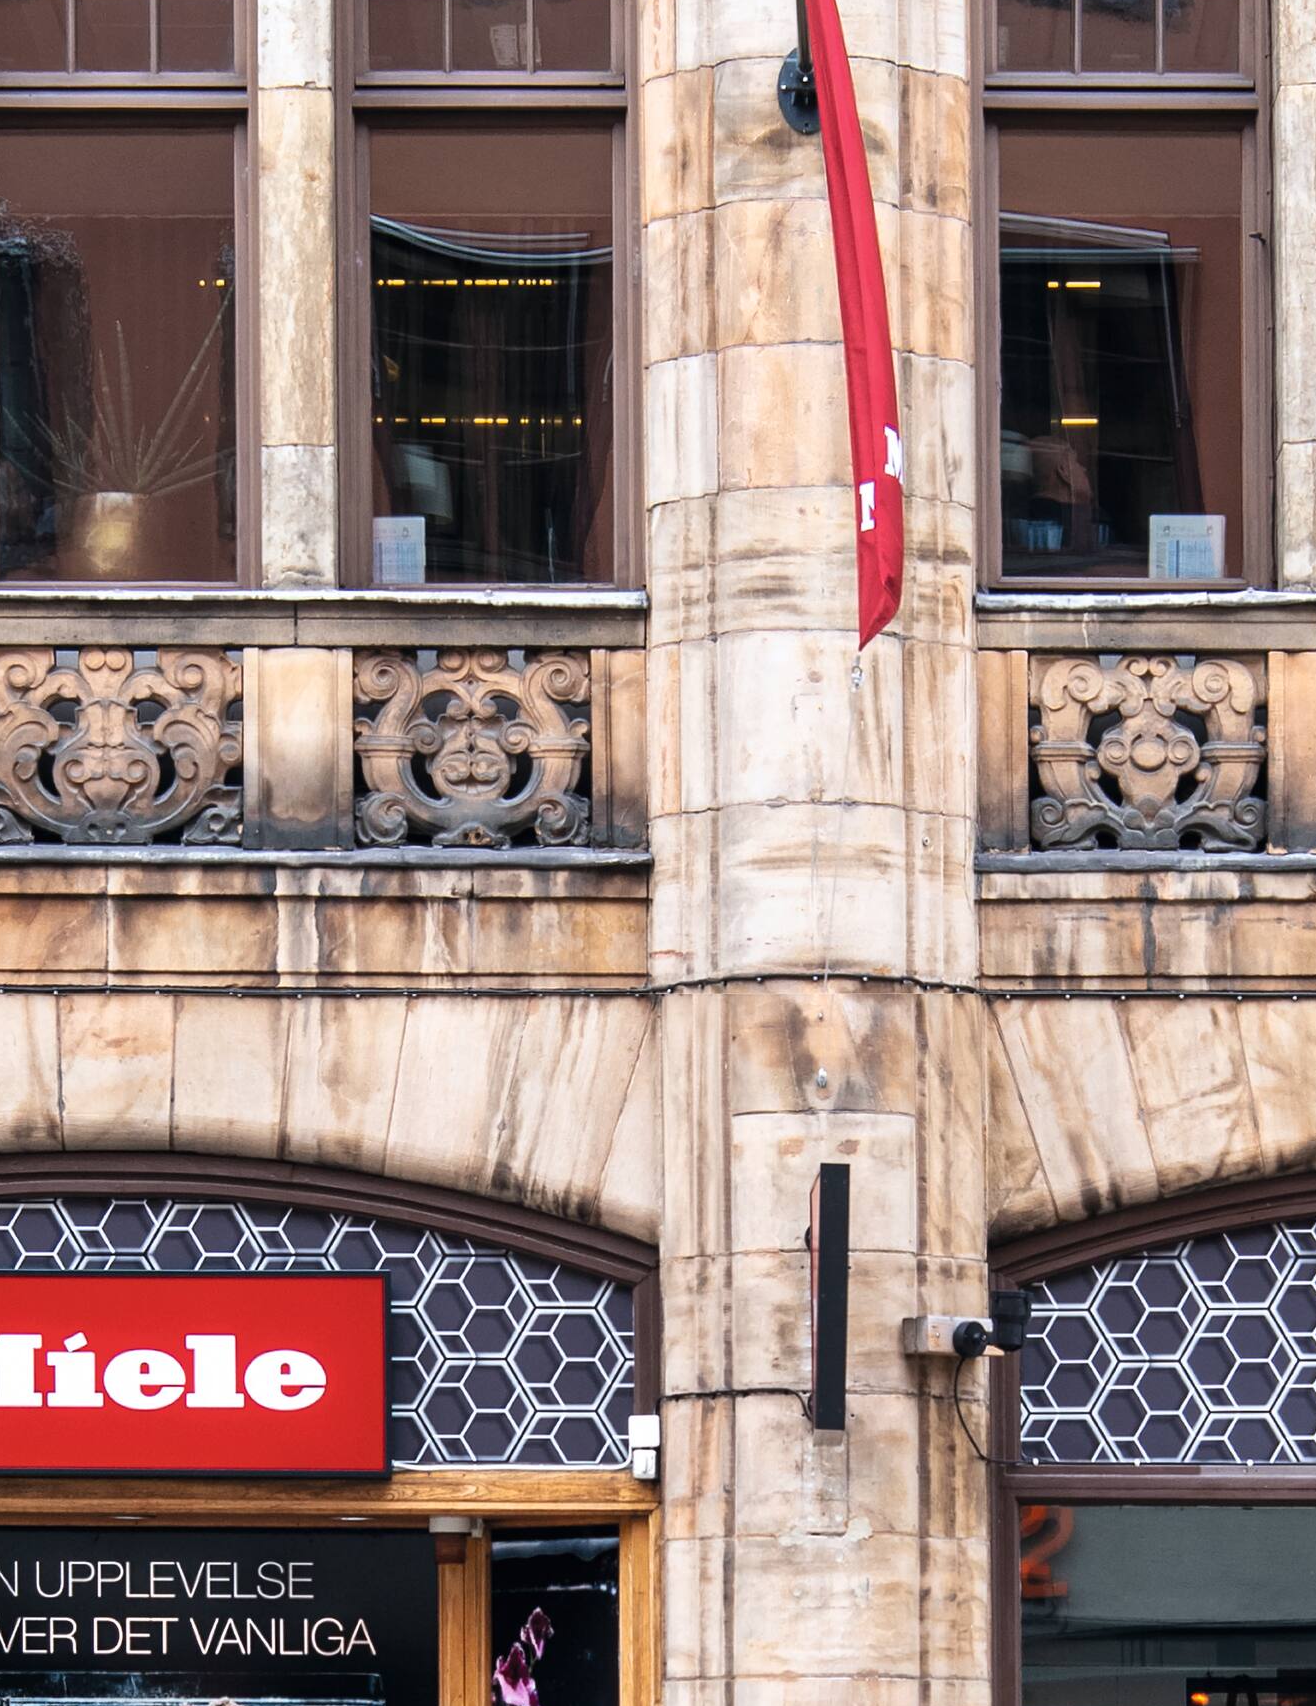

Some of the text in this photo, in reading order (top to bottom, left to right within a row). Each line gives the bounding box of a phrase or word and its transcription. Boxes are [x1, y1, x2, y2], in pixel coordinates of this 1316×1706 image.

[35, 1560, 315, 1600] UPPLEVELSE
[93, 1617, 180, 1657] DET
[189, 1617, 377, 1657] VANLIGA
